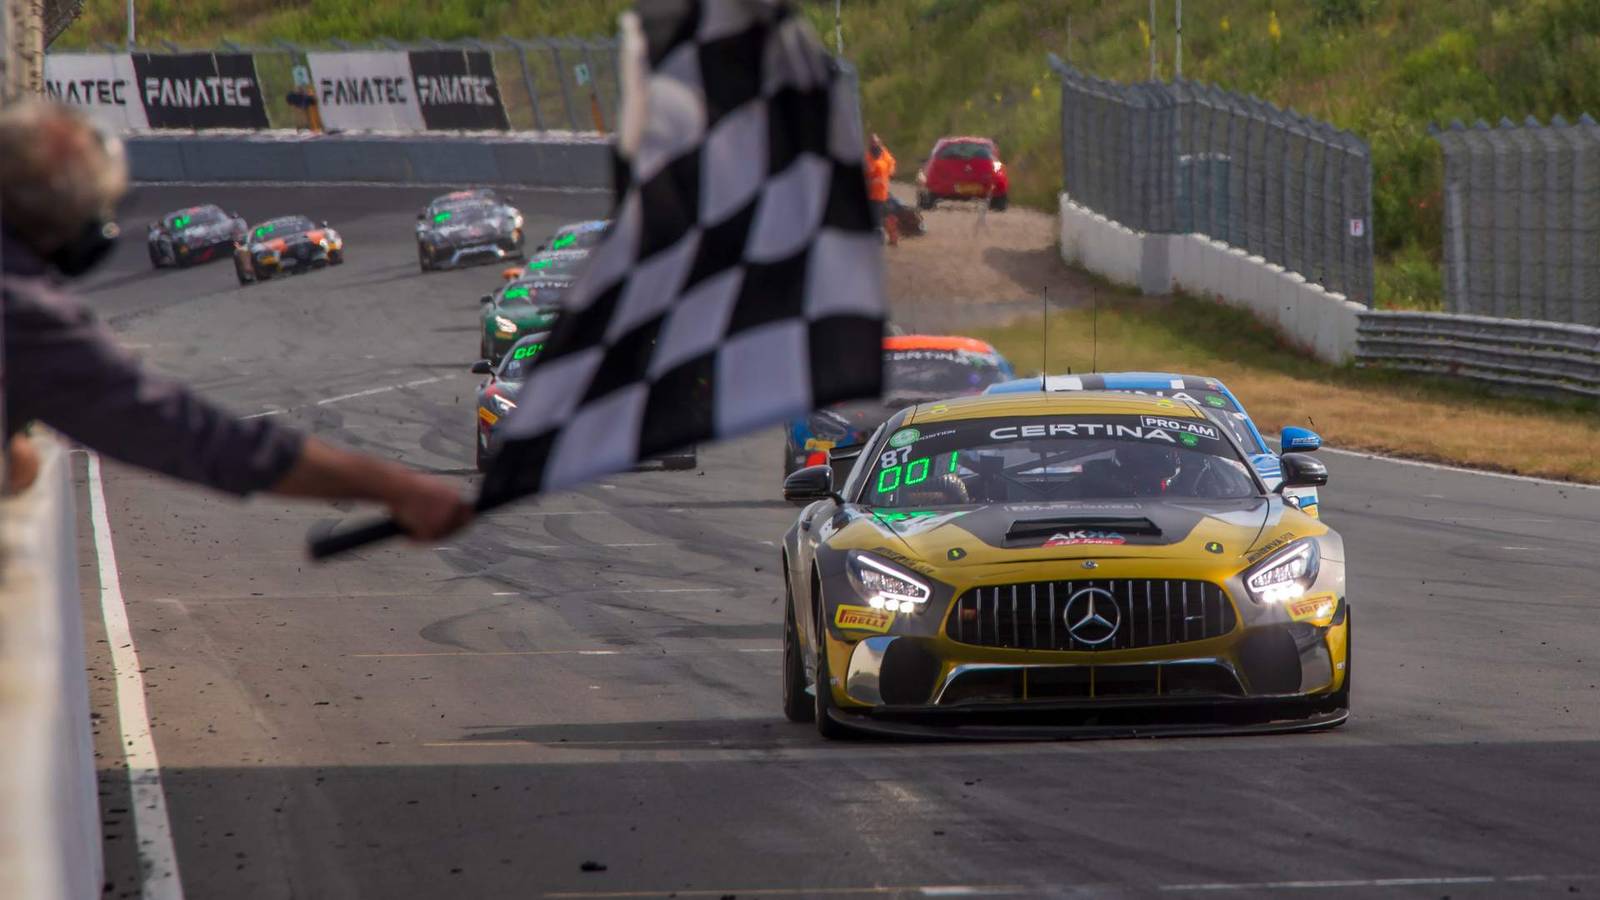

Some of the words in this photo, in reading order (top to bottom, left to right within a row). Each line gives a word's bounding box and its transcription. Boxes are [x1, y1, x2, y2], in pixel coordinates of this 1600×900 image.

[145, 77, 251, 107] FANATEC
[321, 76, 407, 105] FANATEC
[417, 75, 495, 106] FANATEC
[989, 423, 1177, 444] CERTINA
[1146, 417, 1215, 438] PRO-AM
[881, 445, 913, 468] 87
[878, 450, 959, 493] 001
[838, 608, 888, 629] PIRELLI
